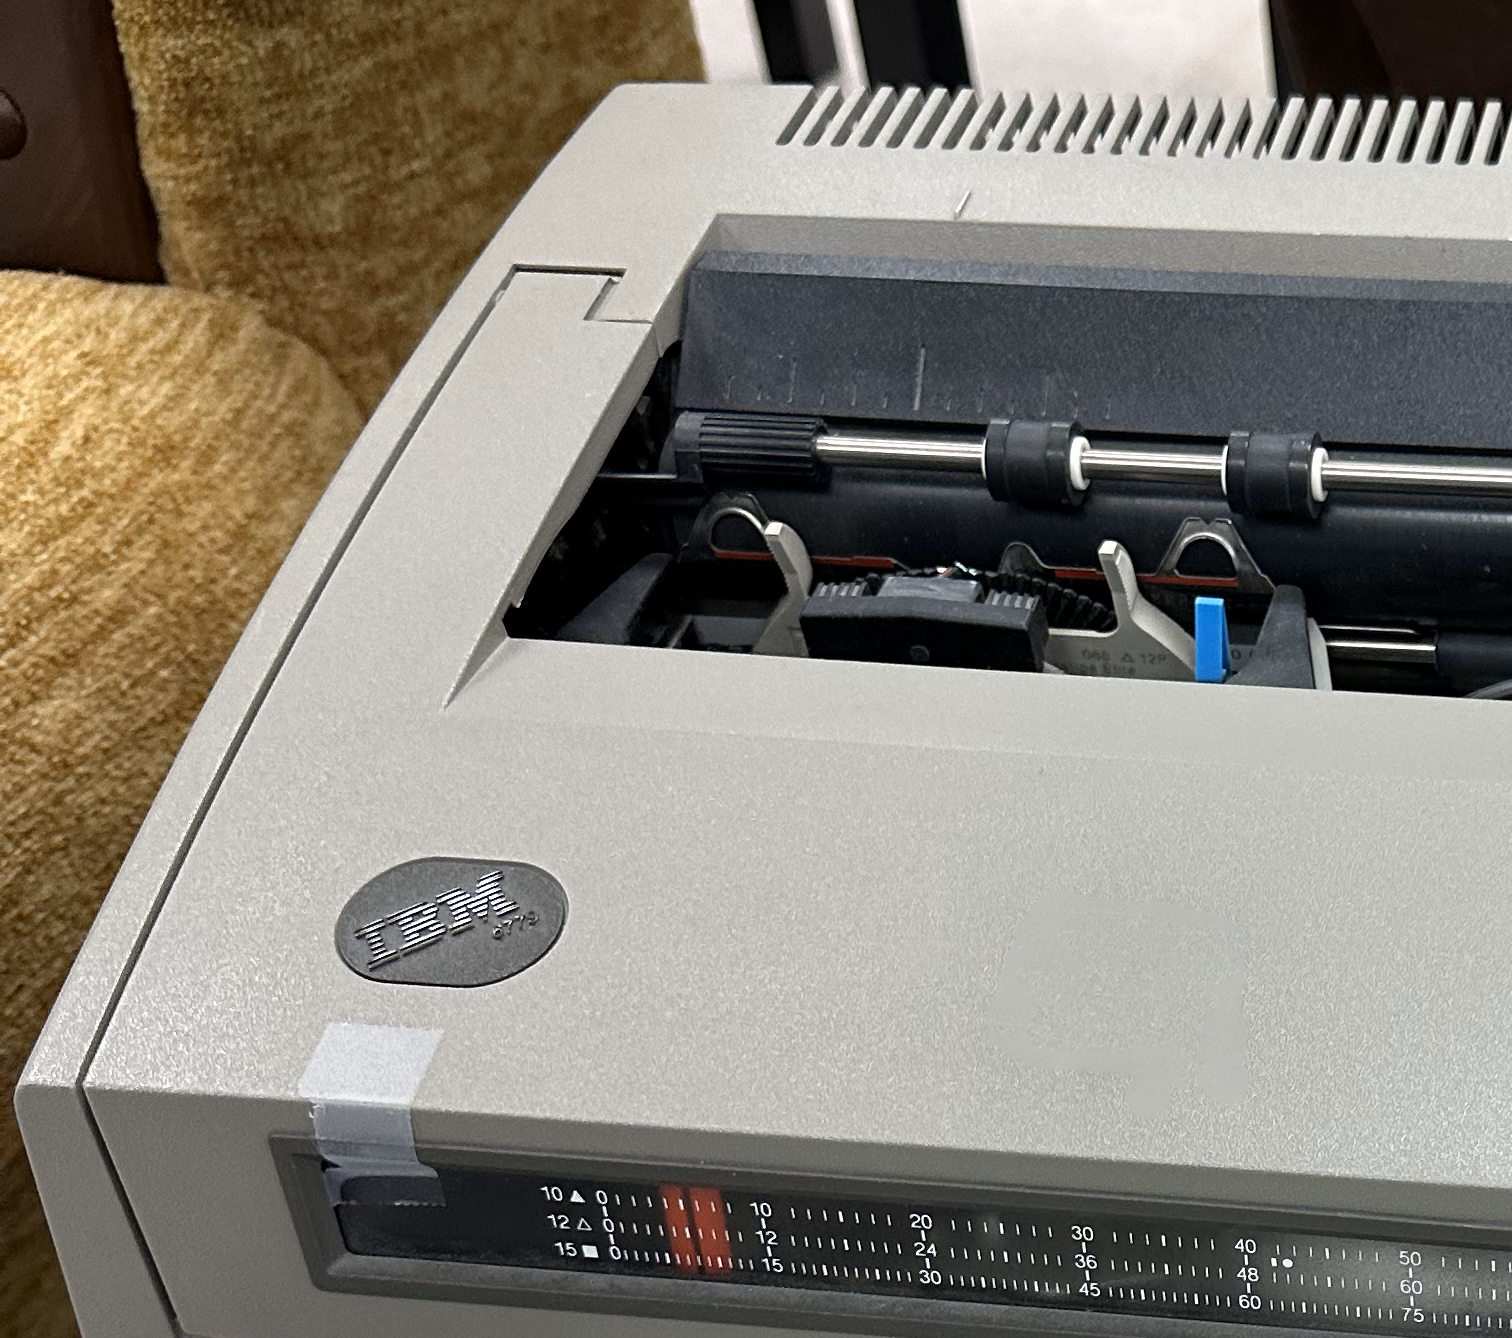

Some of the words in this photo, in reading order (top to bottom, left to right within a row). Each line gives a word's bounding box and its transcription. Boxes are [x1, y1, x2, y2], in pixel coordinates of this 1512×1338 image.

[354, 871, 520, 971] IBM
[541, 1186, 563, 1202] 10
[596, 1190, 608, 1204] 0
[750, 1202, 772, 1217] 10
[909, 1214, 932, 1229] 20
[1071, 1226, 1094, 1241] 30
[1234, 1239, 1256, 1254] 40
[1399, 1252, 1422, 1267] 50
[547, 1214, 570, 1230] 12
[603, 1218, 615, 1232] 0
[756, 1230, 778, 1246] 12
[914, 1242, 937, 1257] 24
[1074, 1254, 1098, 1269] 36
[1236, 1267, 1259, 1283] 48
[1400, 1280, 1423, 1296] 60
[555, 1242, 577, 1256] 15
[610, 1246, 622, 1260] 0
[762, 1258, 783, 1273] 15
[919, 1270, 942, 1285] 30
[1078, 1282, 1101, 1298] 45
[1238, 1295, 1261, 1310] 60
[1401, 1308, 1424, 1323] 75
